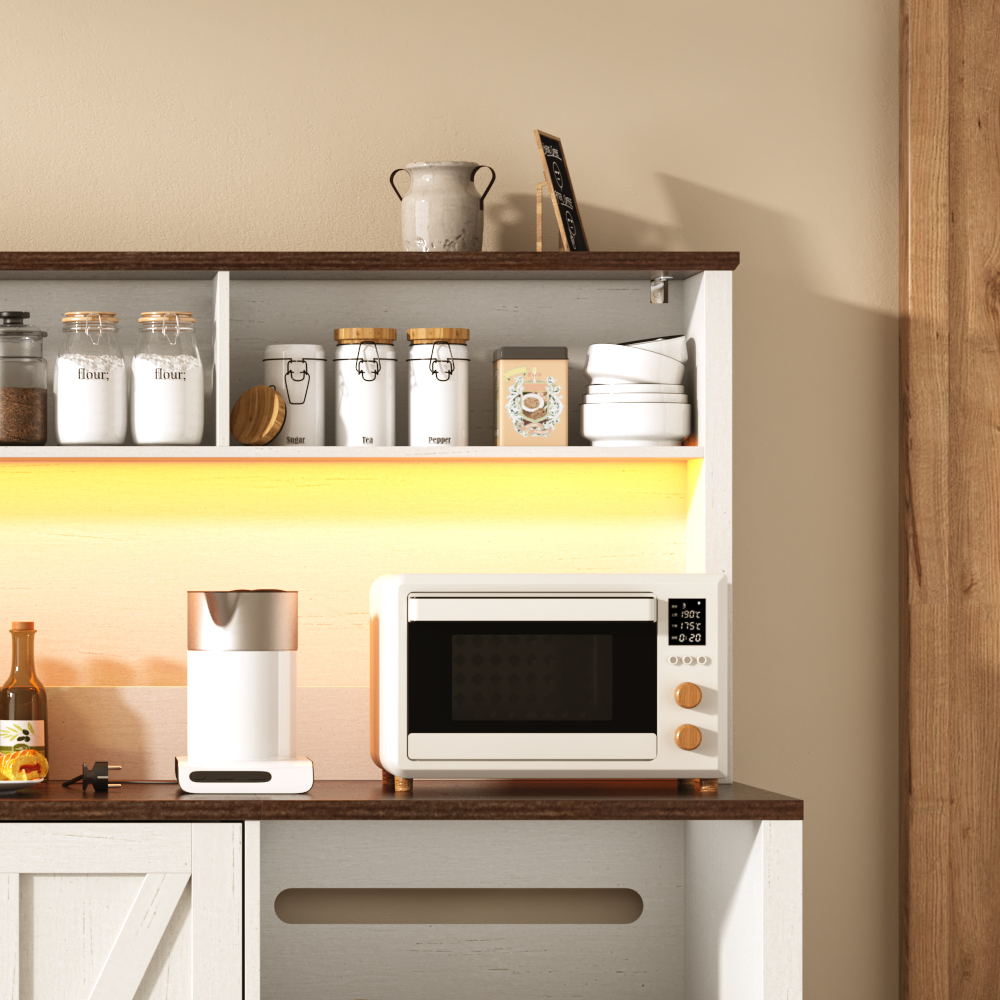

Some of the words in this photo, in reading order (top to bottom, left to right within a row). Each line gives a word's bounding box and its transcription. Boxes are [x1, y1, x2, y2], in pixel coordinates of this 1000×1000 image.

[78, 368, 109, 382] flour;
[155, 368, 186, 382] flour;
[286, 436, 305, 445] Sugar
[362, 436, 374, 444] Tea
[428, 436, 452, 445] Pepper
